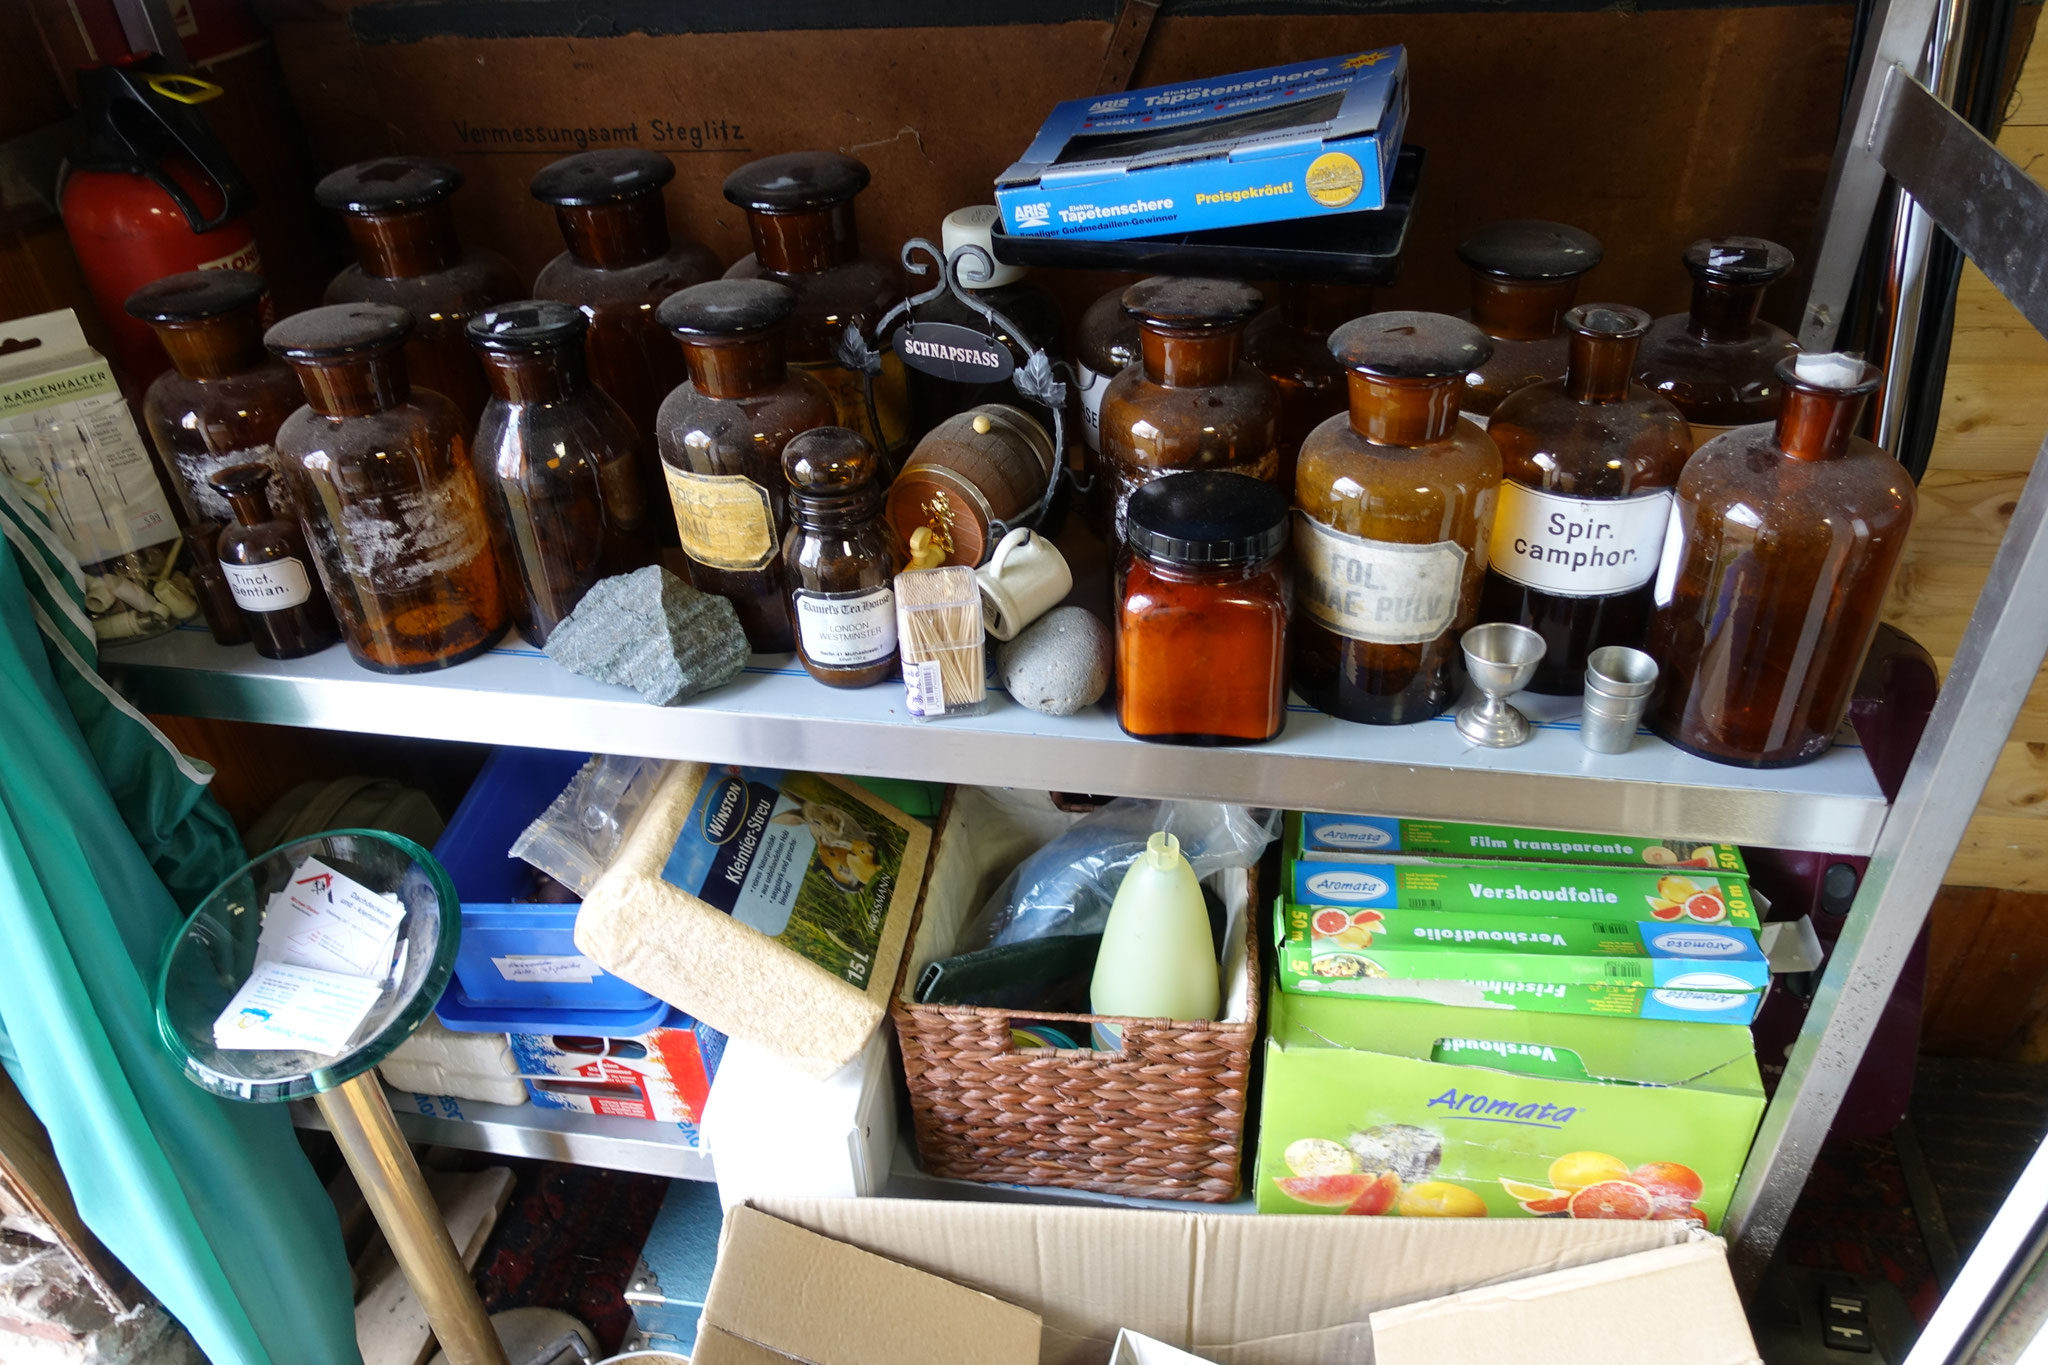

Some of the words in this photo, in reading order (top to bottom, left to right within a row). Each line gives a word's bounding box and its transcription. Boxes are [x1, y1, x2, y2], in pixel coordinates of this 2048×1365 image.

[1143, 67, 1329, 107] Tapetenschere
[1159, 99, 1215, 113] Tapeten
[1315, 70, 1357, 83] Wand
[1162, 86, 1202, 98] Elektro
[1095, 117, 1136, 128] exakt
[1154, 108, 1204, 121] sauber
[1227, 94, 1274, 109] sicher
[1298, 76, 1354, 93] schnell
[452, 119, 638, 149] Vermessungsamt
[652, 119, 745, 149] Steglitz
[1195, 181, 1294, 206] Preisgekrönt!
[1058, 197, 1175, 225] Tapetenschere
[1068, 203, 1095, 213] Elektro
[1062, 213, 1178, 236] Goldmedaillen-Gewinner
[904, 339, 1000, 369] SCHNAPSFASS
[4, 371, 107, 404] KARTENHALTER
[1547, 512, 1615, 544] Spir.
[1513, 537, 1639, 573] camphor.
[232, 572, 273, 586] Tinct.
[1330, 552, 1387, 591] FOL.
[841, 604, 861, 615] Tea
[862, 594, 891, 611] House
[818, 626, 883, 641] WESTMINSTER
[829, 621, 870, 634] LONDON
[706, 781, 743, 838] WINSTON
[723, 797, 772, 886] Kleintier-Streu
[1323, 828, 1382, 843] Aromata
[1469, 835, 1508, 849] Film
[1512, 838, 1634, 855] transparente
[757, 833, 777, 872] Naturprodukt
[1719, 850, 1740, 870] 50
[1316, 878, 1378, 892] Aromata
[1468, 882, 1619, 905] Vershoudfolie
[1729, 884, 1744, 898] m
[866, 872, 893, 933] ROSSMANN
[1731, 899, 1750, 919] 50
[1291, 910, 1309, 929] 50
[1291, 931, 1304, 942] m
[1413, 926, 1568, 947] Vershoudfolie
[1666, 939, 1734, 951] Aromata
[846, 961, 868, 983] 15
[1426, 1087, 1578, 1123] Aromata
